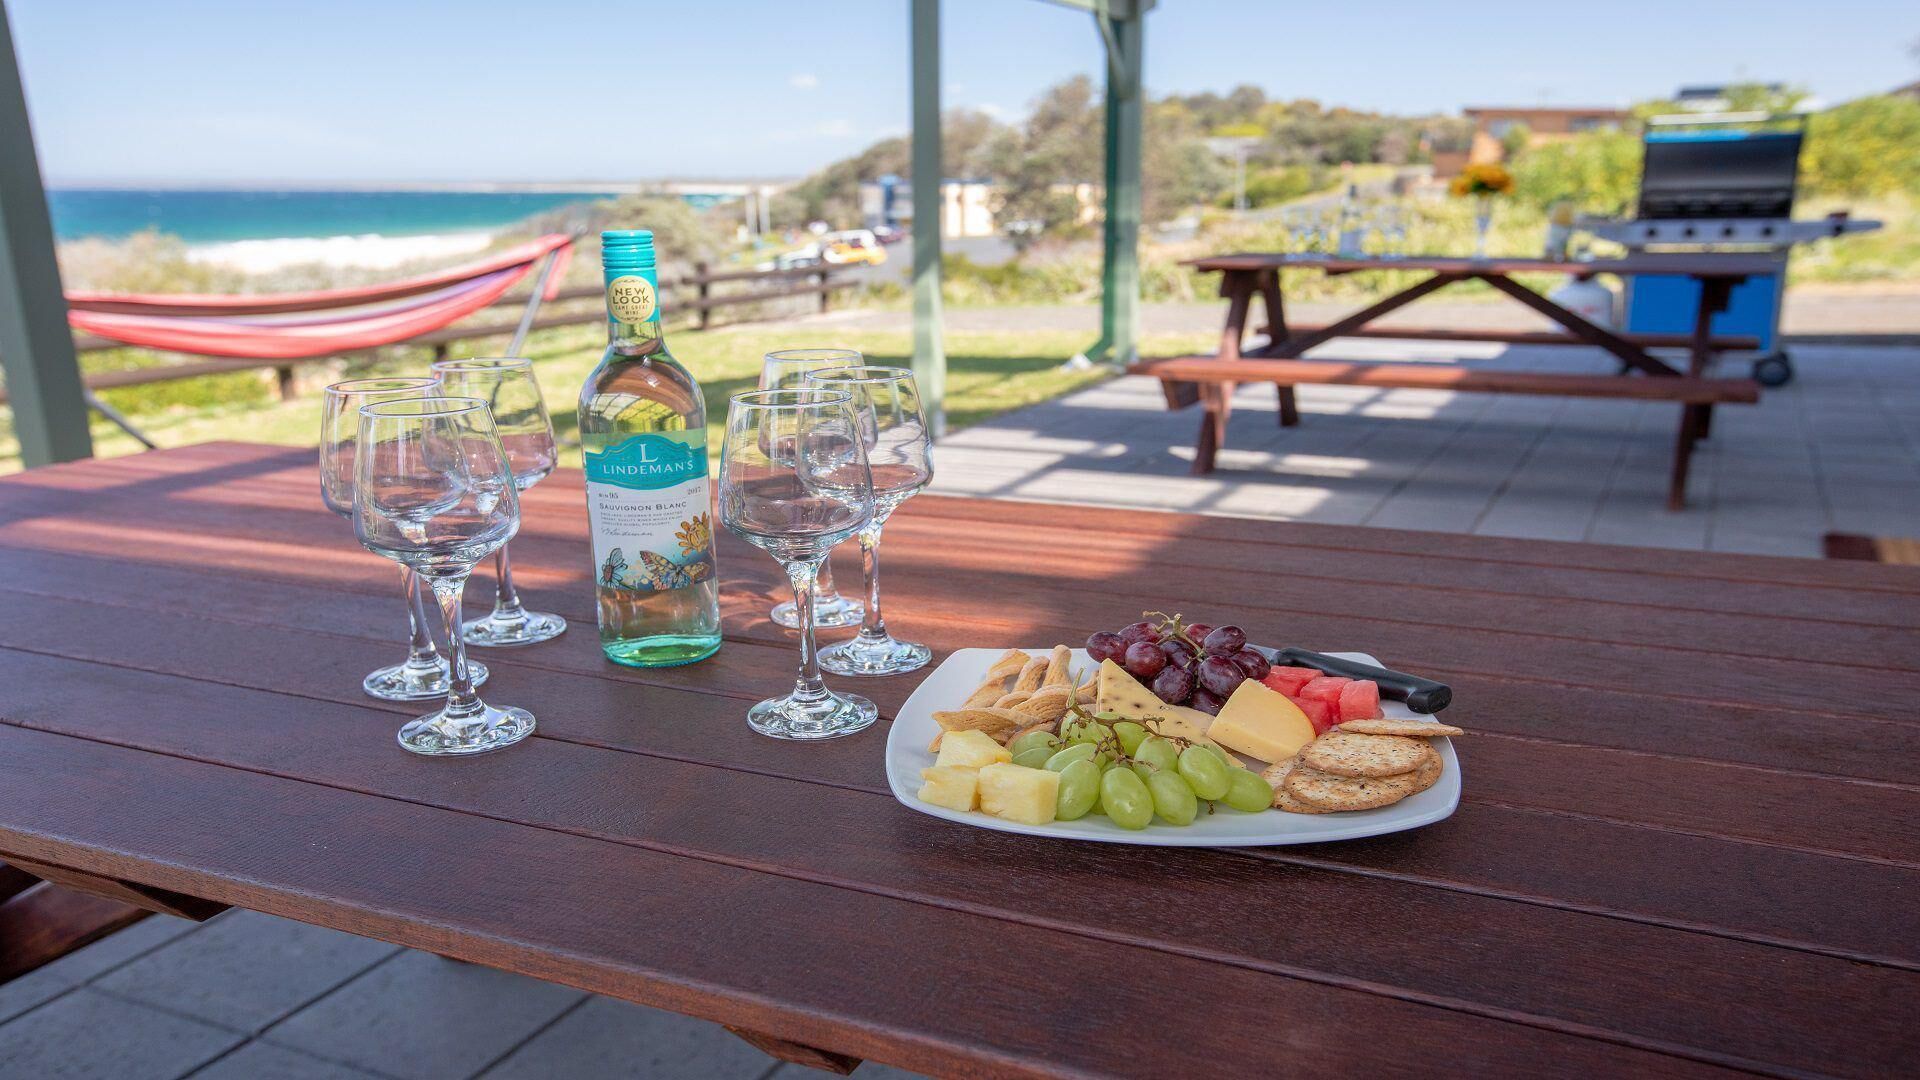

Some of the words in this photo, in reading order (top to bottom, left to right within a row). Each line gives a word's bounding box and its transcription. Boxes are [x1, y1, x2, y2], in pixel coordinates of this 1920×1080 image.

[615, 288, 645, 296] NEW
[612, 295, 650, 305] LOOK
[640, 443, 659, 463] L
[603, 460, 694, 475] LINDEMAN'S
[687, 486, 702, 495] 2017
[599, 502, 652, 511] SAUVIGNON
[655, 501, 687, 511] BLANC
